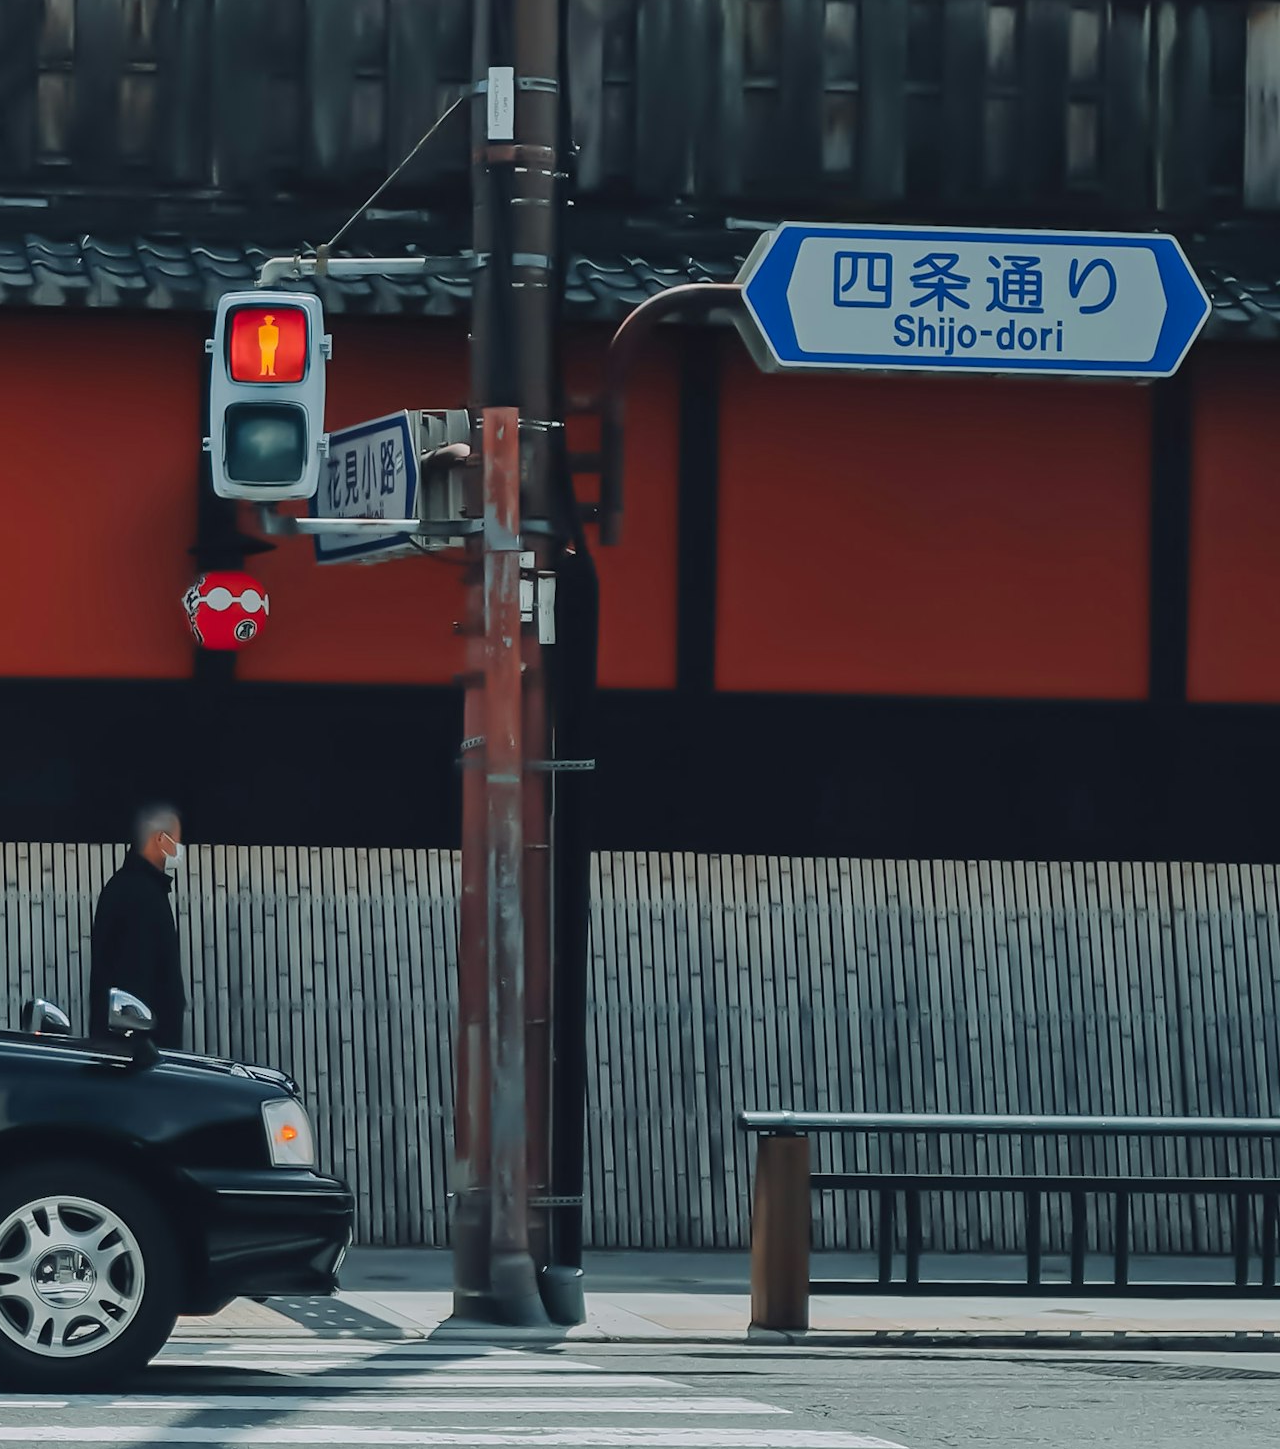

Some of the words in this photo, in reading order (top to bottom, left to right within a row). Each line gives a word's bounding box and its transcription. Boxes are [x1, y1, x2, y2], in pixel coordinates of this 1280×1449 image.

[833, 251, 1117, 315] 四条通り
[893, 314, 1063, 356] Shijo-dori
[327, 439, 395, 511] 花見小路
